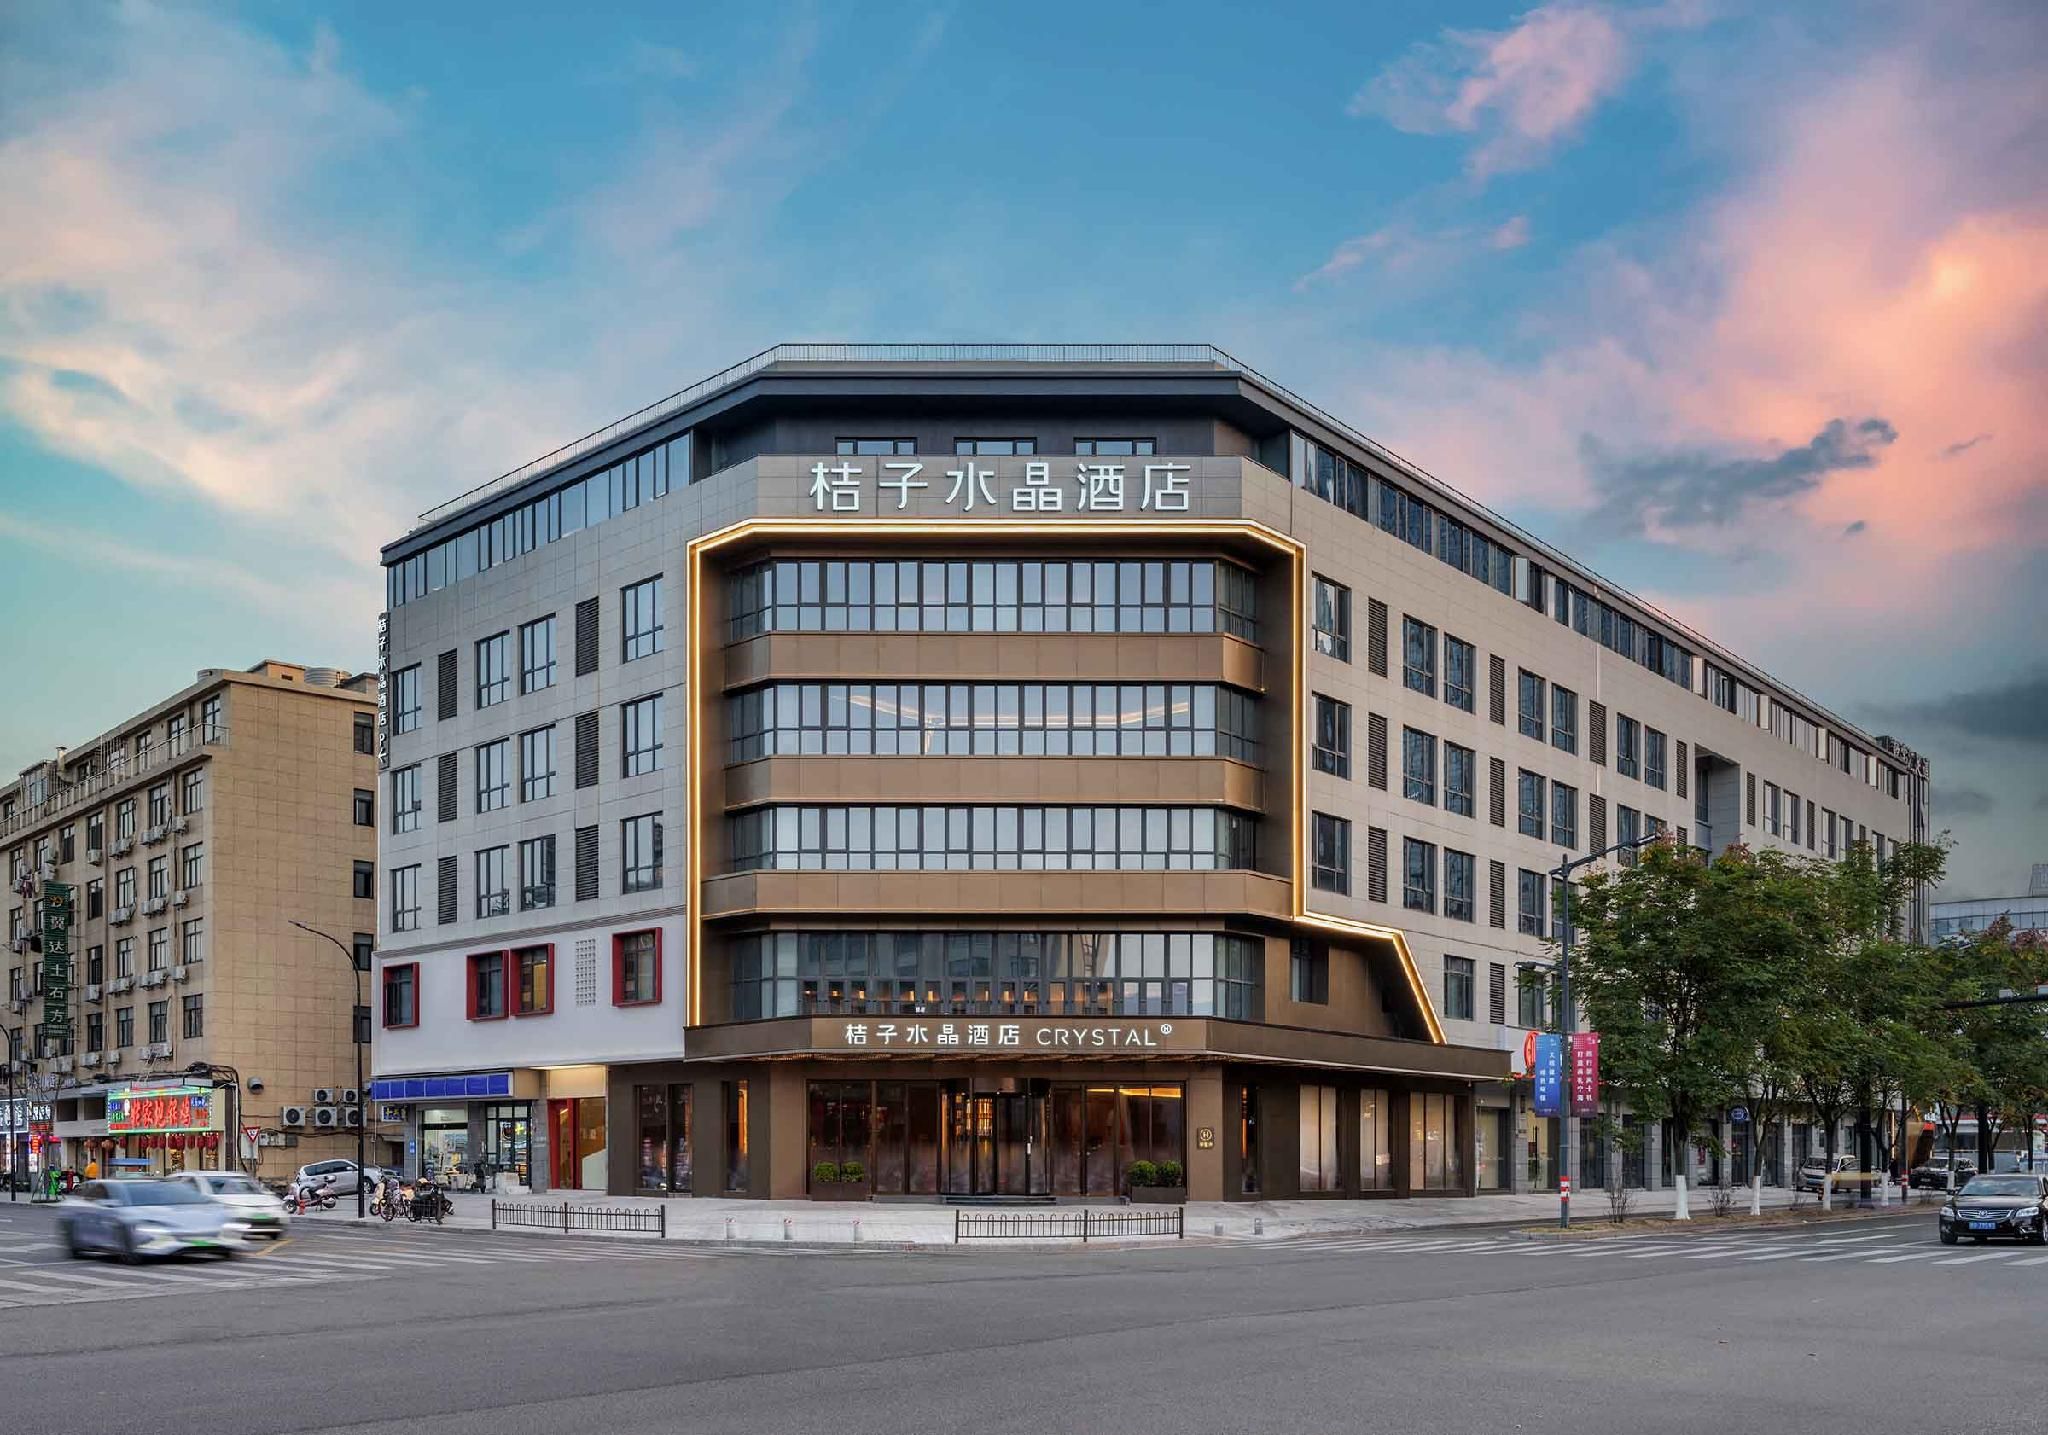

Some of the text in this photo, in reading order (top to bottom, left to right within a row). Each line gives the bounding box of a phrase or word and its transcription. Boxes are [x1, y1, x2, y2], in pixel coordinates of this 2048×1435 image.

[810, 461, 1191, 511] 桔子水晶酒店
[378, 619, 388, 726] 桔子水晶酒店
[845, 1023, 1020, 1046] 桔子水晶酒店
[1036, 1027, 1157, 1046] CRYSTAL
